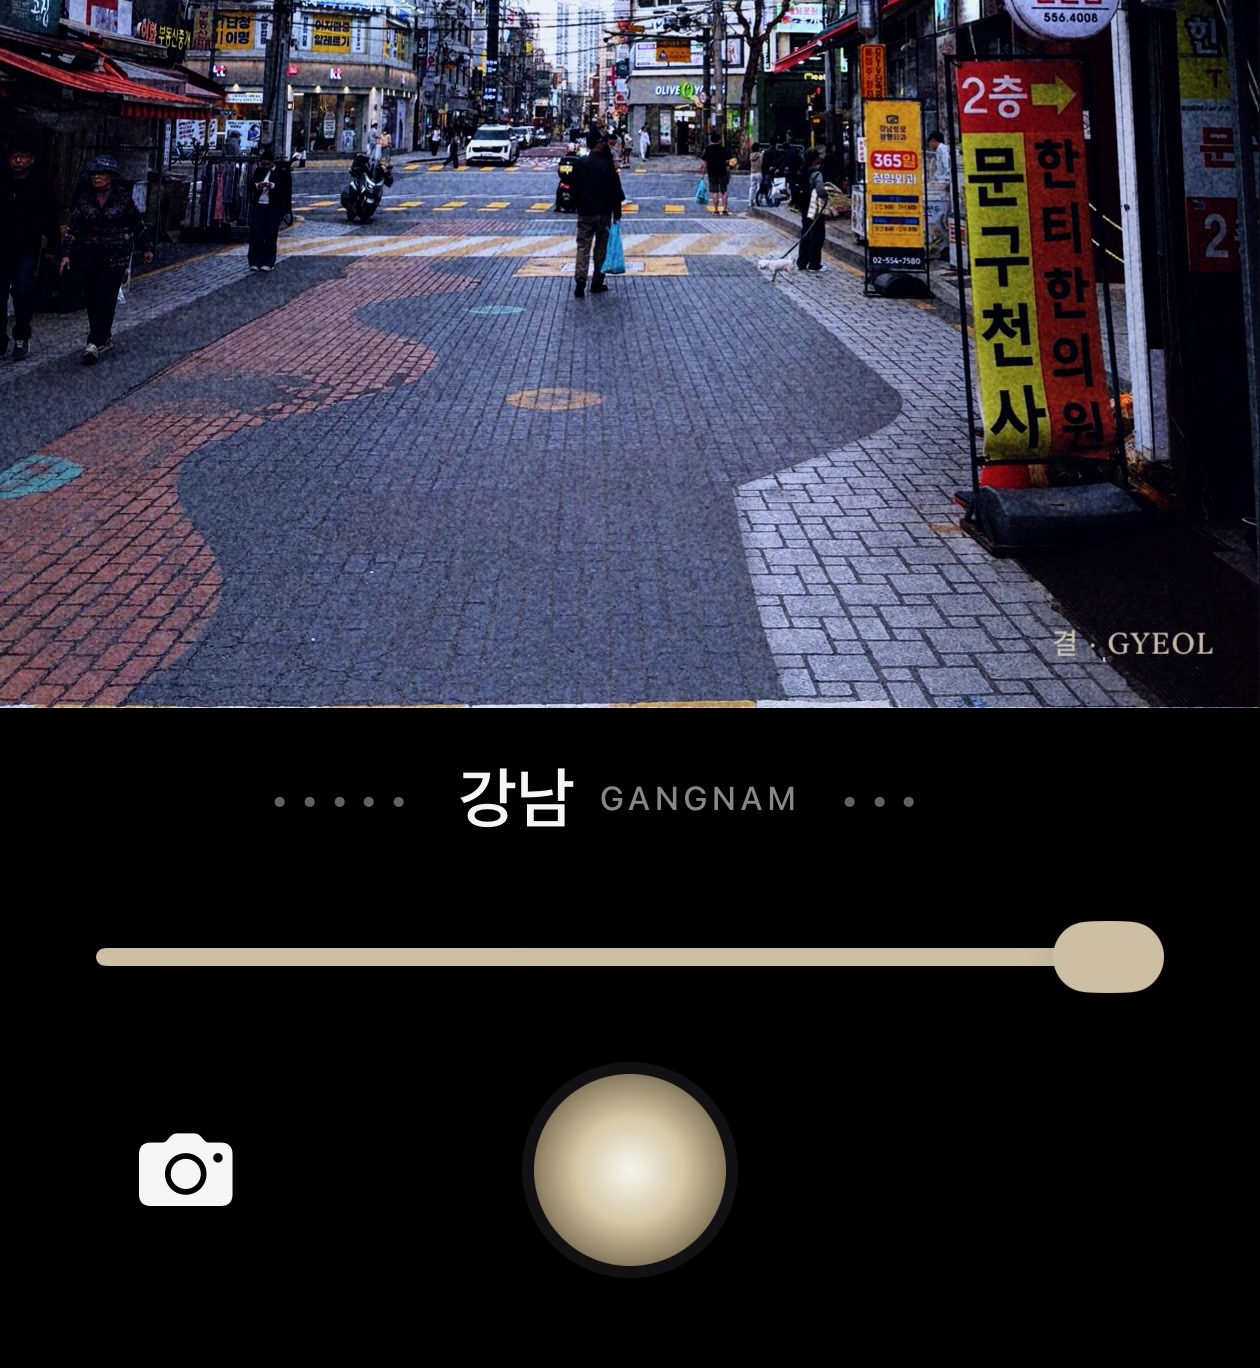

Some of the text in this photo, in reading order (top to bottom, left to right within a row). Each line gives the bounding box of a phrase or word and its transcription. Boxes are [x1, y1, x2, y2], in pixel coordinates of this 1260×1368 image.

[1043, 12, 1099, 24] 556.4008
[655, 85, 681, 95] OLIVE
[961, 75, 1028, 119] 2층
[873, 153, 917, 169] 365일
[872, 256, 921, 265] 02-554-7580
[967, 147, 1047, 450] 문구천사
[1034, 138, 1105, 454] 한티한의원
